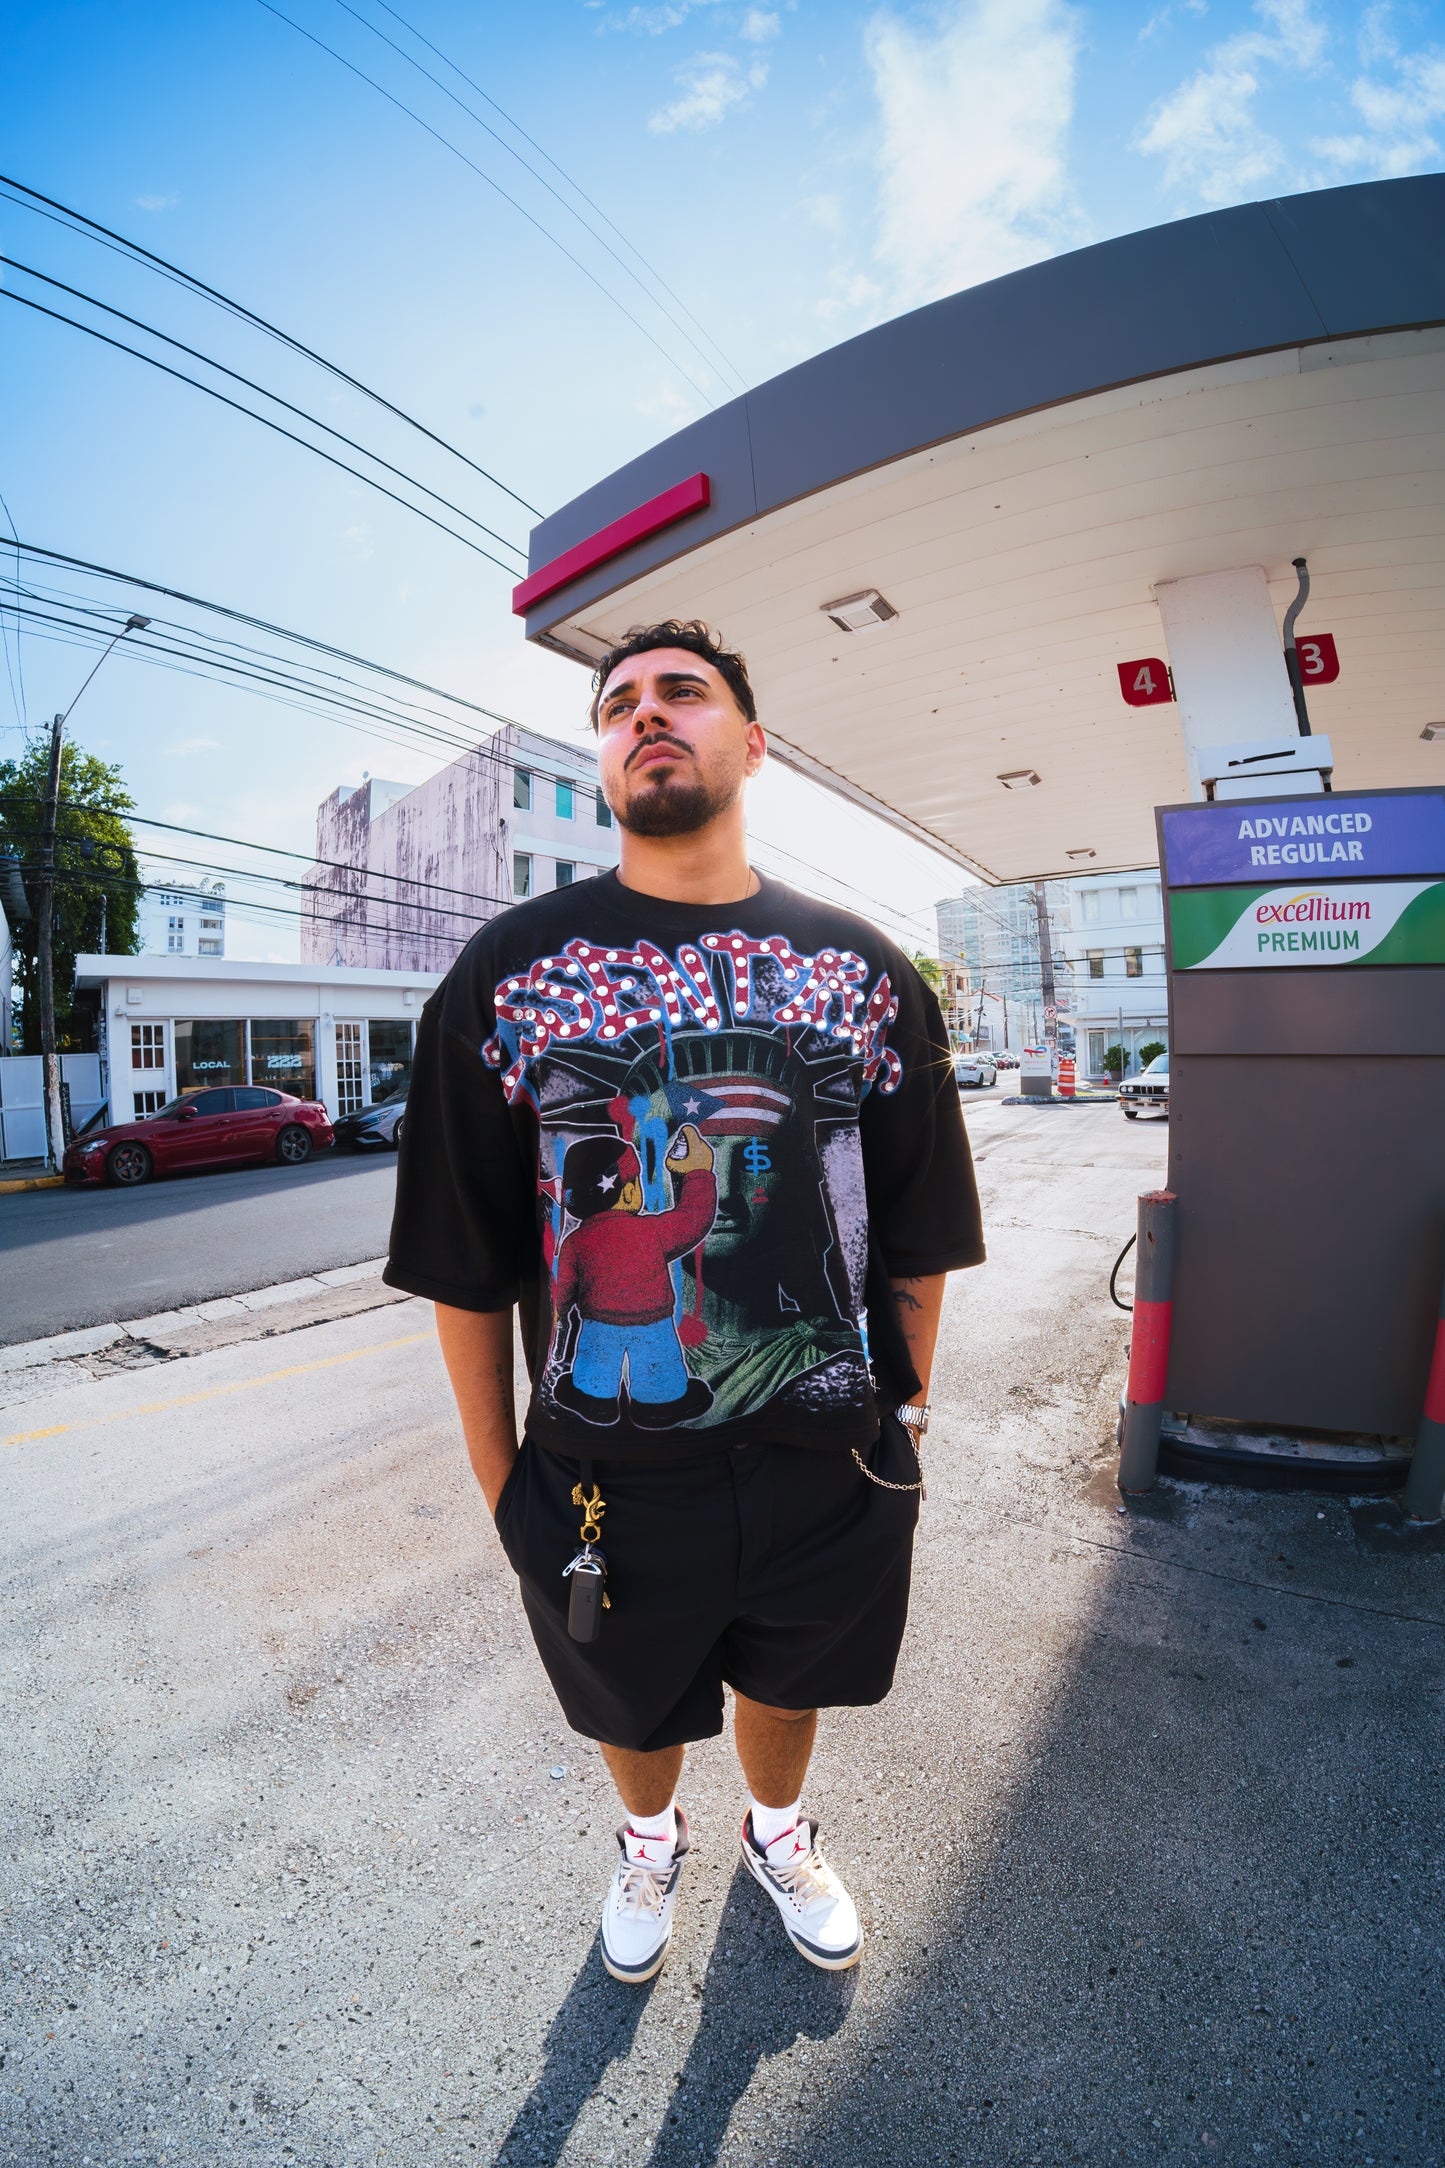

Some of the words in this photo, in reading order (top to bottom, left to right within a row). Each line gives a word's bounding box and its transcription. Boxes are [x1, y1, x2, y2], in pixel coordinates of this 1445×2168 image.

[1301, 643, 1325, 675] 3
[1133, 666, 1157, 696] 4
[1238, 812, 1373, 840] ADVANCED
[1250, 840, 1365, 866] REGULAR
[1256, 896, 1371, 924] excellium
[1257, 930, 1360, 953] PREMIUM
[192, 1060, 231, 1070] LOCAL
